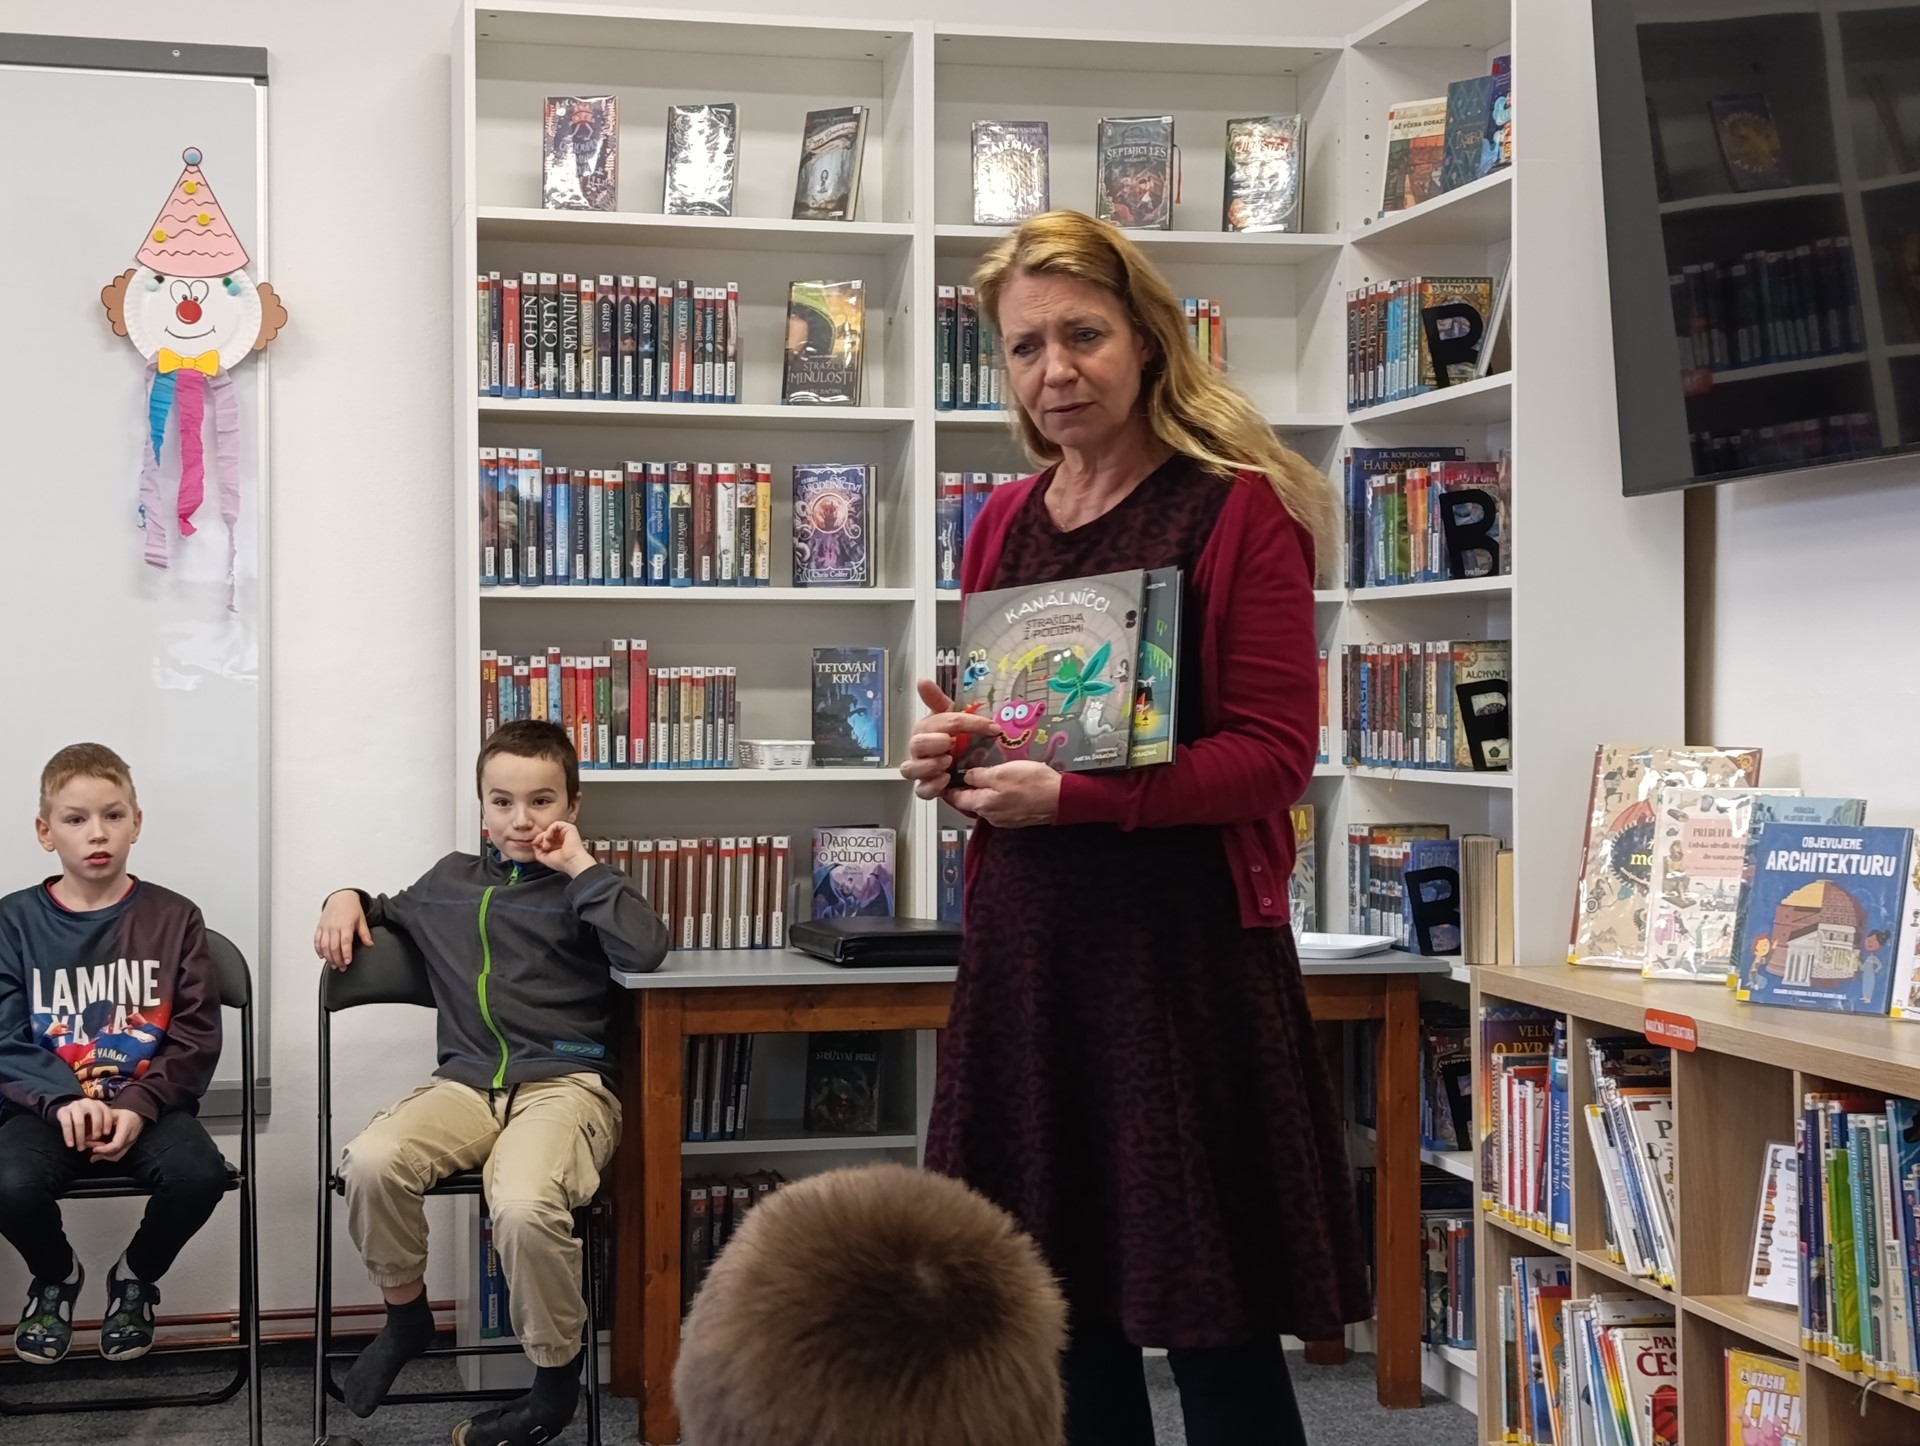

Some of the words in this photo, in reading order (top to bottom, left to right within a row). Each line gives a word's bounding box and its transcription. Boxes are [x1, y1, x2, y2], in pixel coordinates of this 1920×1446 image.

[522, 294, 538, 348] OHEŇ
[540, 296, 558, 347] ČISTÝ
[560, 292, 578, 350] SPLYNUTÍ
[1364, 460, 1406, 474] HARRY
[576, 495, 584, 516] FOWL
[576, 518, 584, 550] ARTEMIS
[830, 570, 849, 578] Colfer
[1004, 588, 1111, 624] KANÁLNÍČCI
[1026, 612, 1086, 630] STRAŠIDLA
[1032, 624, 1084, 638] PODZEMÍ
[816, 660, 876, 672] TETOVÁNÍ
[832, 673, 860, 684] KRVÍ
[820, 832, 884, 850] NAROZEN
[1802, 836, 1864, 850] OBJEVUJEME
[820, 852, 828, 861] O
[831, 849, 886, 864] PŮLNOCI
[1765, 850, 1896, 878] ARCHITEKTURU
[32, 958, 160, 1015] LAMINE
[1552, 1170, 1560, 1197] Velká
